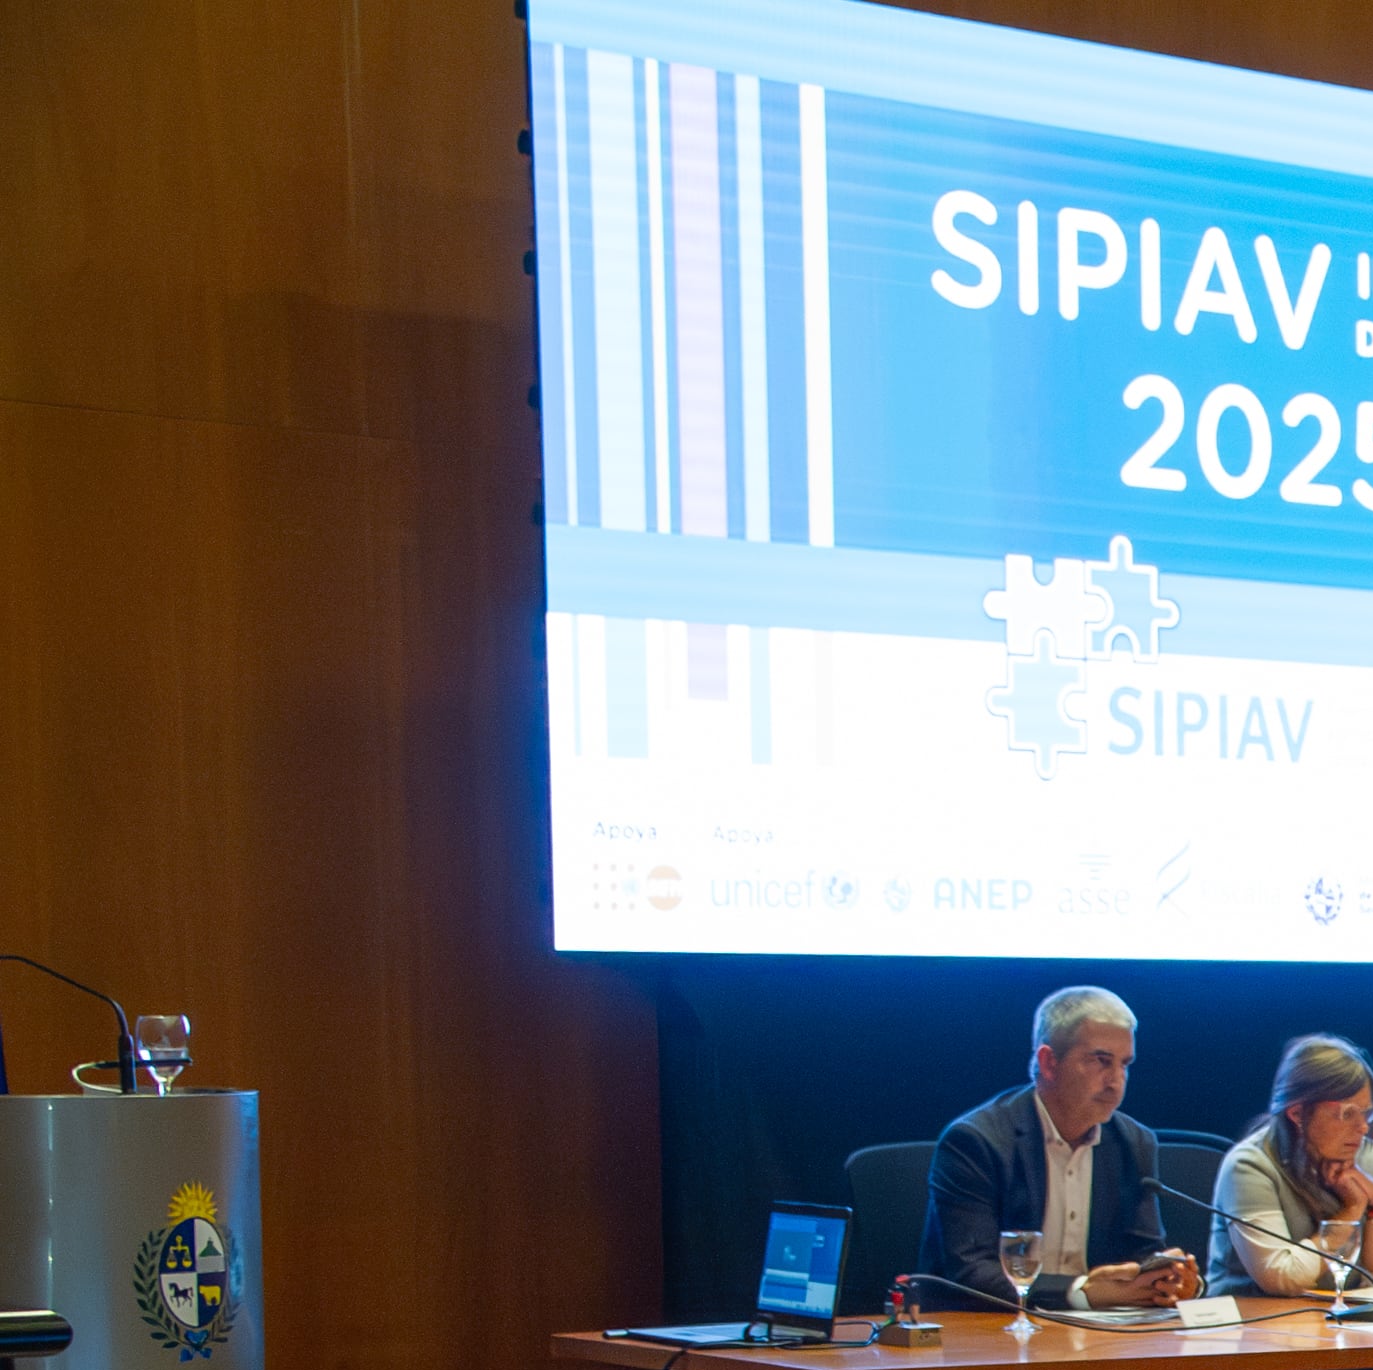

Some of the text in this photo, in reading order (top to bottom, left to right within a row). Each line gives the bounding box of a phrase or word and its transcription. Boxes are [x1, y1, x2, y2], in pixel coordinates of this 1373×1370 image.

[931, 189, 1332, 351] SIPIAV
[1107, 685, 1315, 764] SIPIAV
[711, 869, 816, 908] unicef
[933, 876, 1034, 911] ANEP
